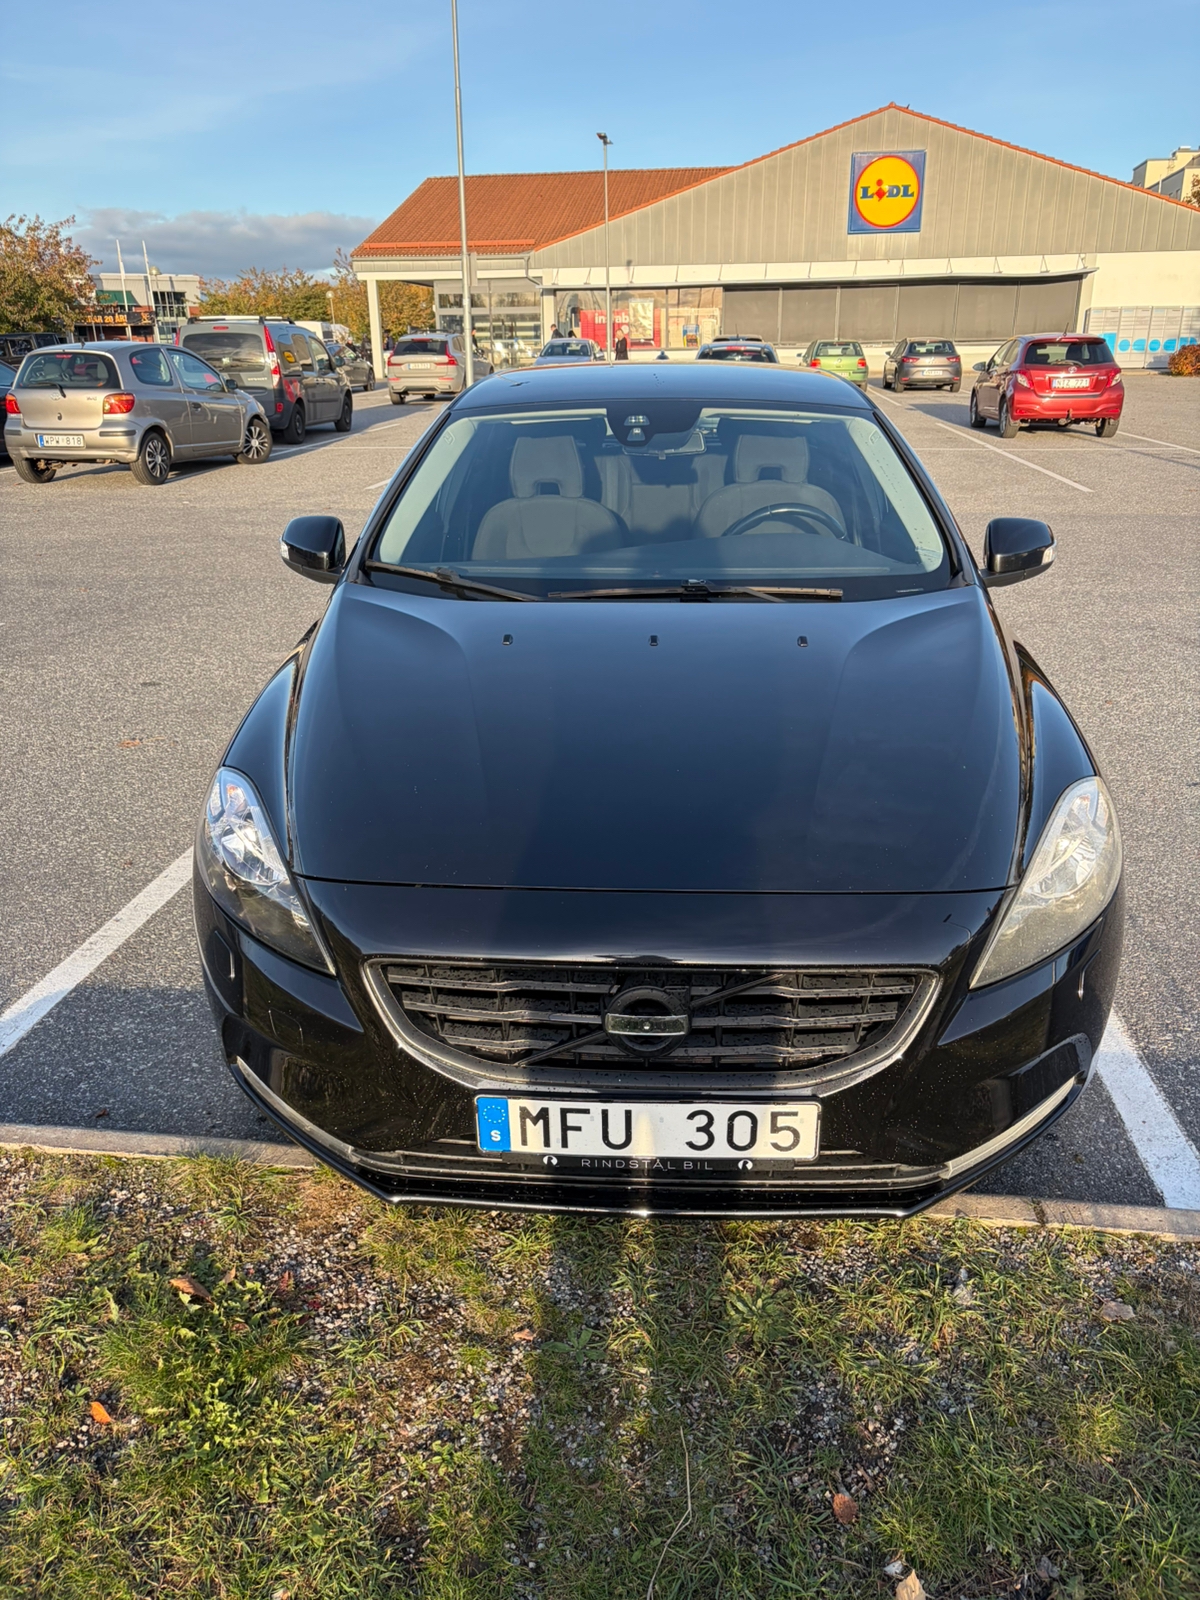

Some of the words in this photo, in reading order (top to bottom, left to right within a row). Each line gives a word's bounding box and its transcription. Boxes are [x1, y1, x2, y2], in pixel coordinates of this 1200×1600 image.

[104, 315, 114, 323] 20
[45, 436, 60, 445] WPW
[66, 436, 82, 445] 818
[519, 1105, 632, 1150] MFU
[685, 1109, 801, 1152] 305
[490, 1129, 501, 1142] S
[581, 1158, 676, 1170] RINDSTÅL
[683, 1160, 713, 1170] BIL
